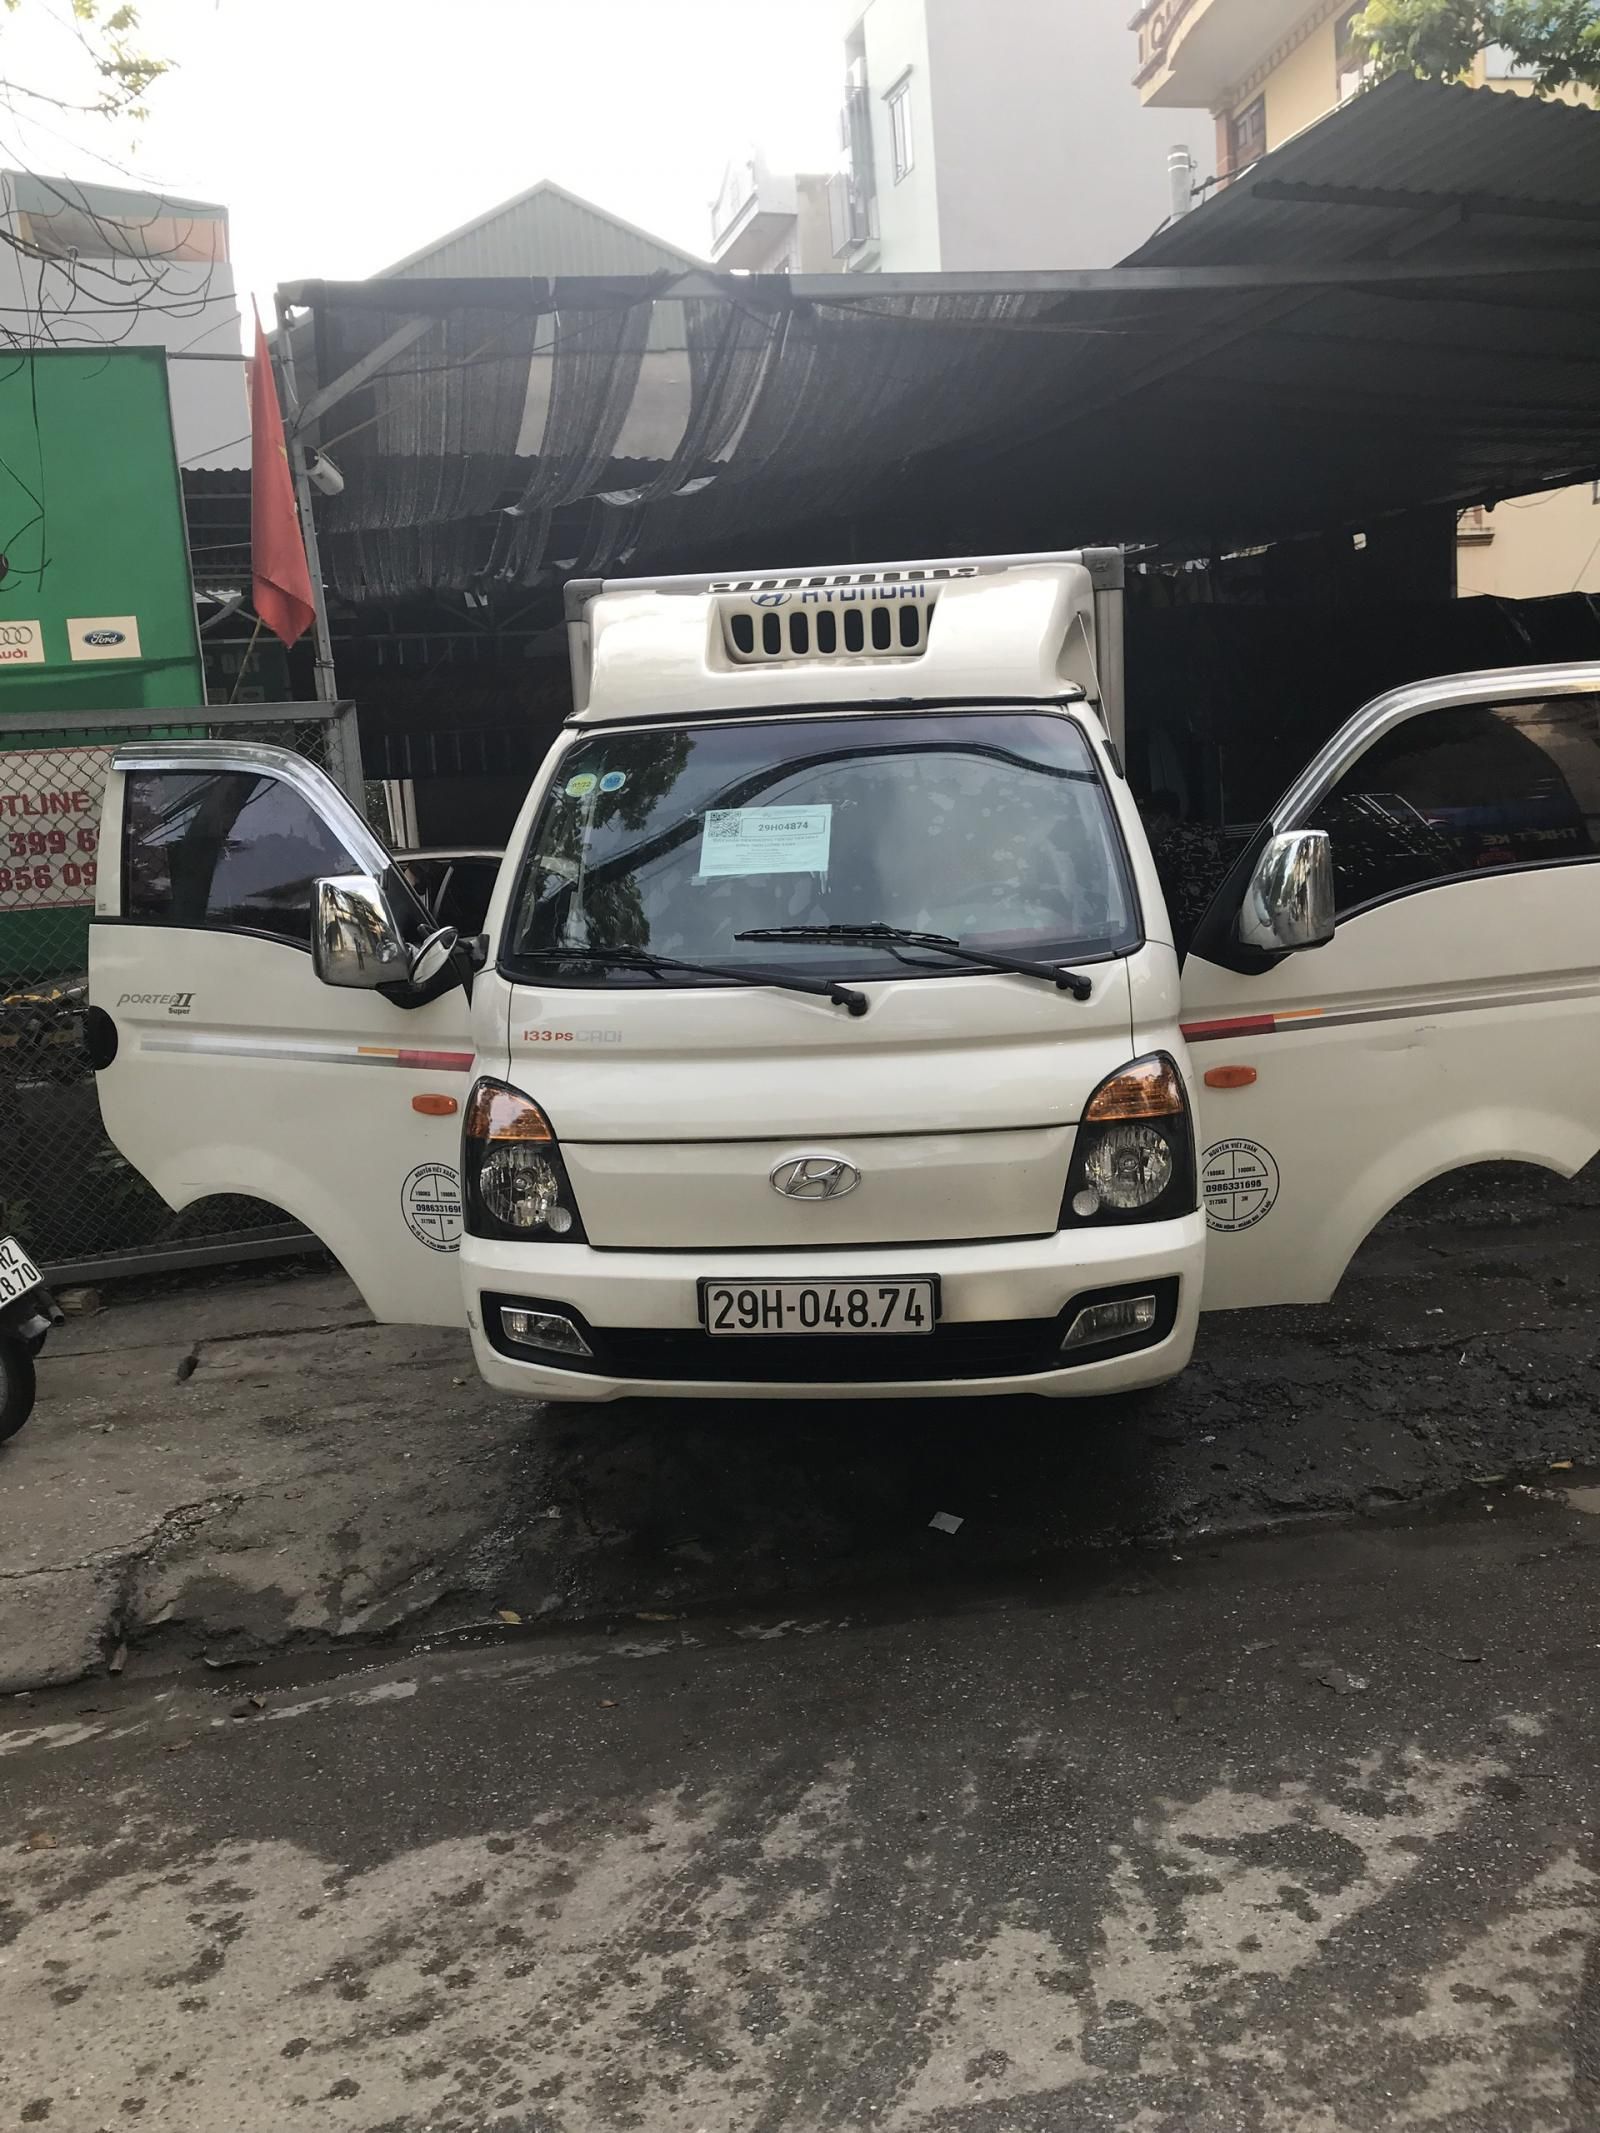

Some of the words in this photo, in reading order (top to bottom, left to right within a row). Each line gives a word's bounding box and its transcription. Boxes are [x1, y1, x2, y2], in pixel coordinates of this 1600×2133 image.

[90, 632, 118, 644] Ford
[0, 790, 92, 817] TLINE
[758, 821, 809, 832] 29H04874
[76, 828, 100, 852] 6
[62, 861, 97, 886] 09
[168, 1007, 191, 1015] Super
[713, 1288, 925, 1329] 29H-048.74
